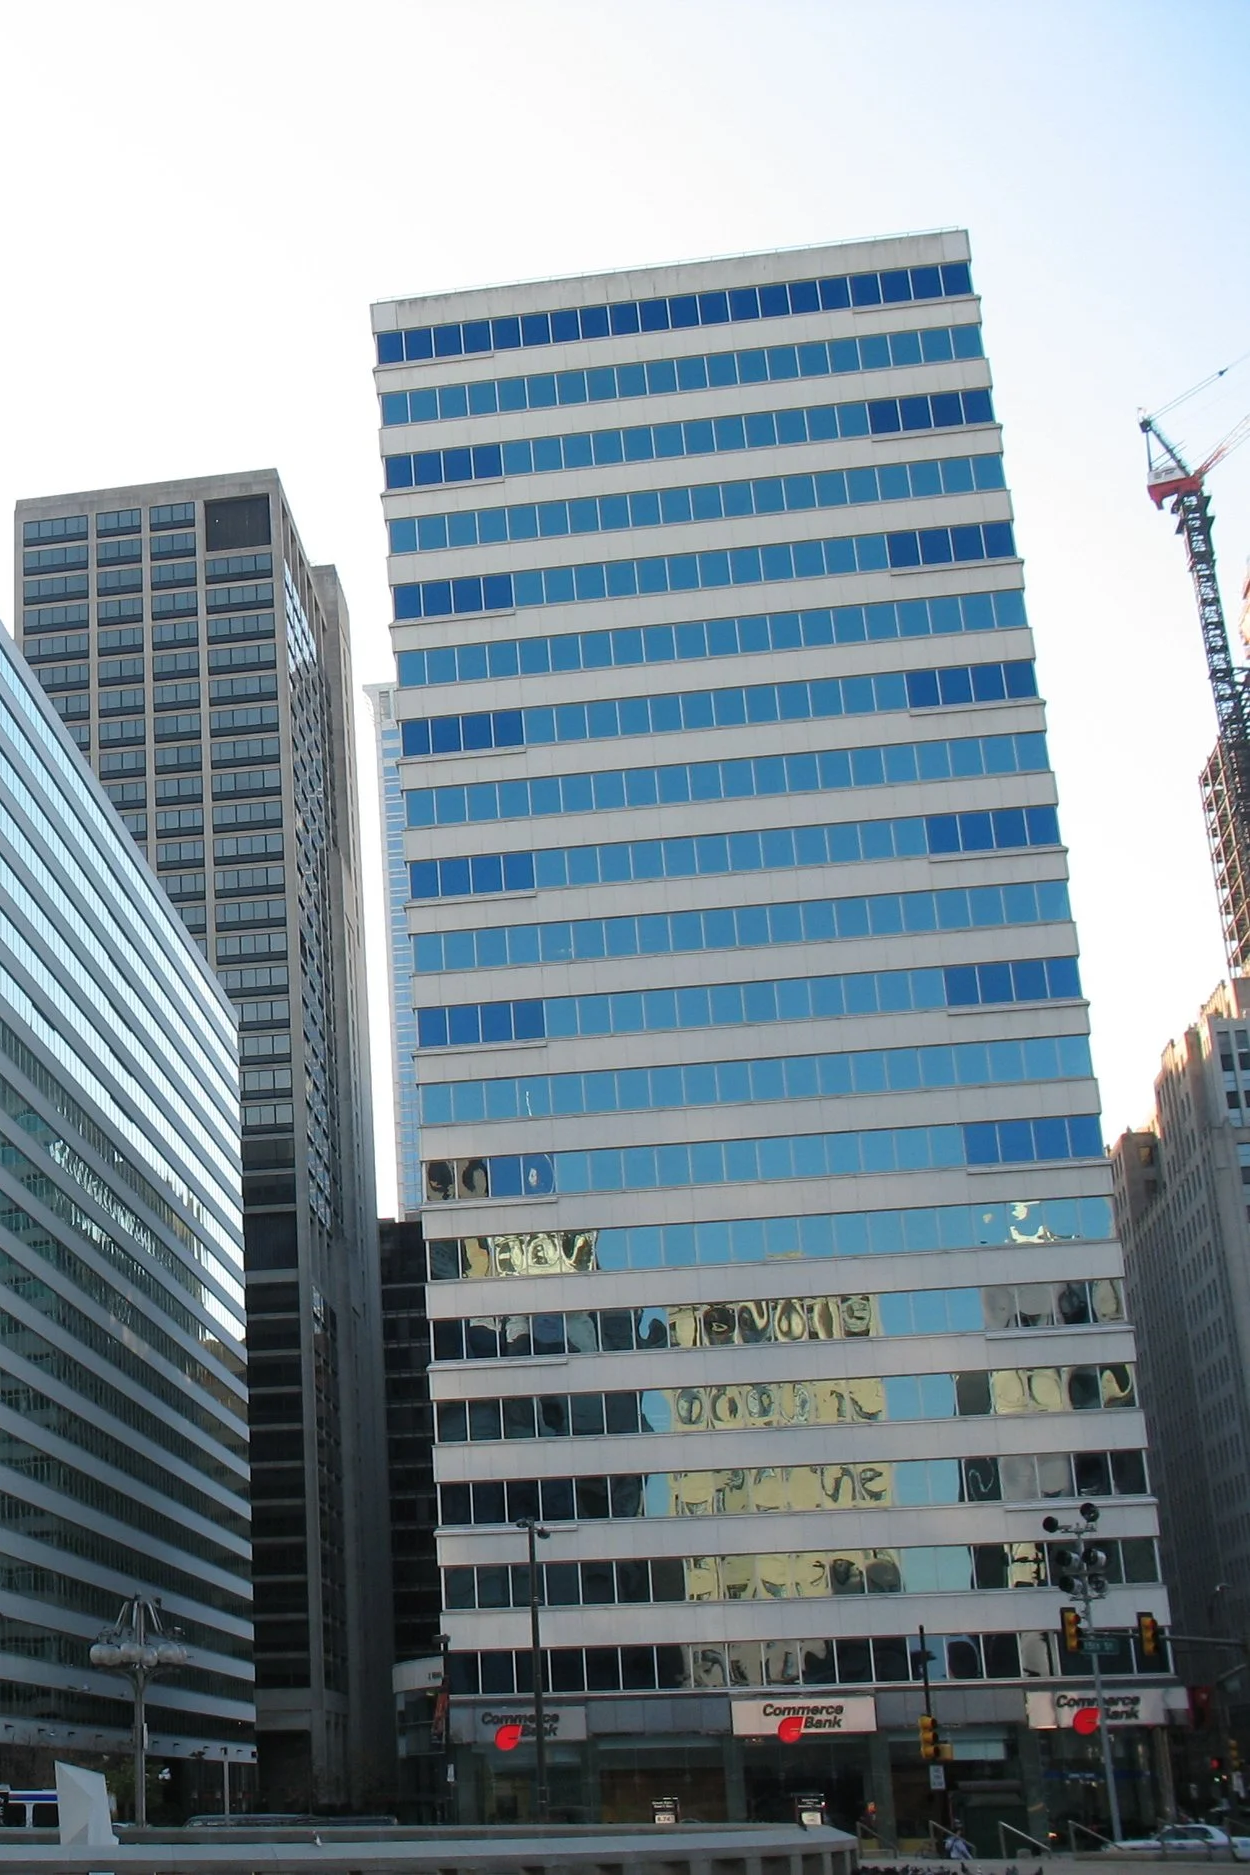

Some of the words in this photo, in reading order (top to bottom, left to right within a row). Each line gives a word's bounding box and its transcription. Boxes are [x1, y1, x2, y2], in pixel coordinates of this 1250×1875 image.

[1056, 1695, 1140, 1708] Commerce
[762, 1703, 844, 1717] Commerce
[481, 1712, 560, 1725] Commece
[803, 1715, 843, 1729] Bank
